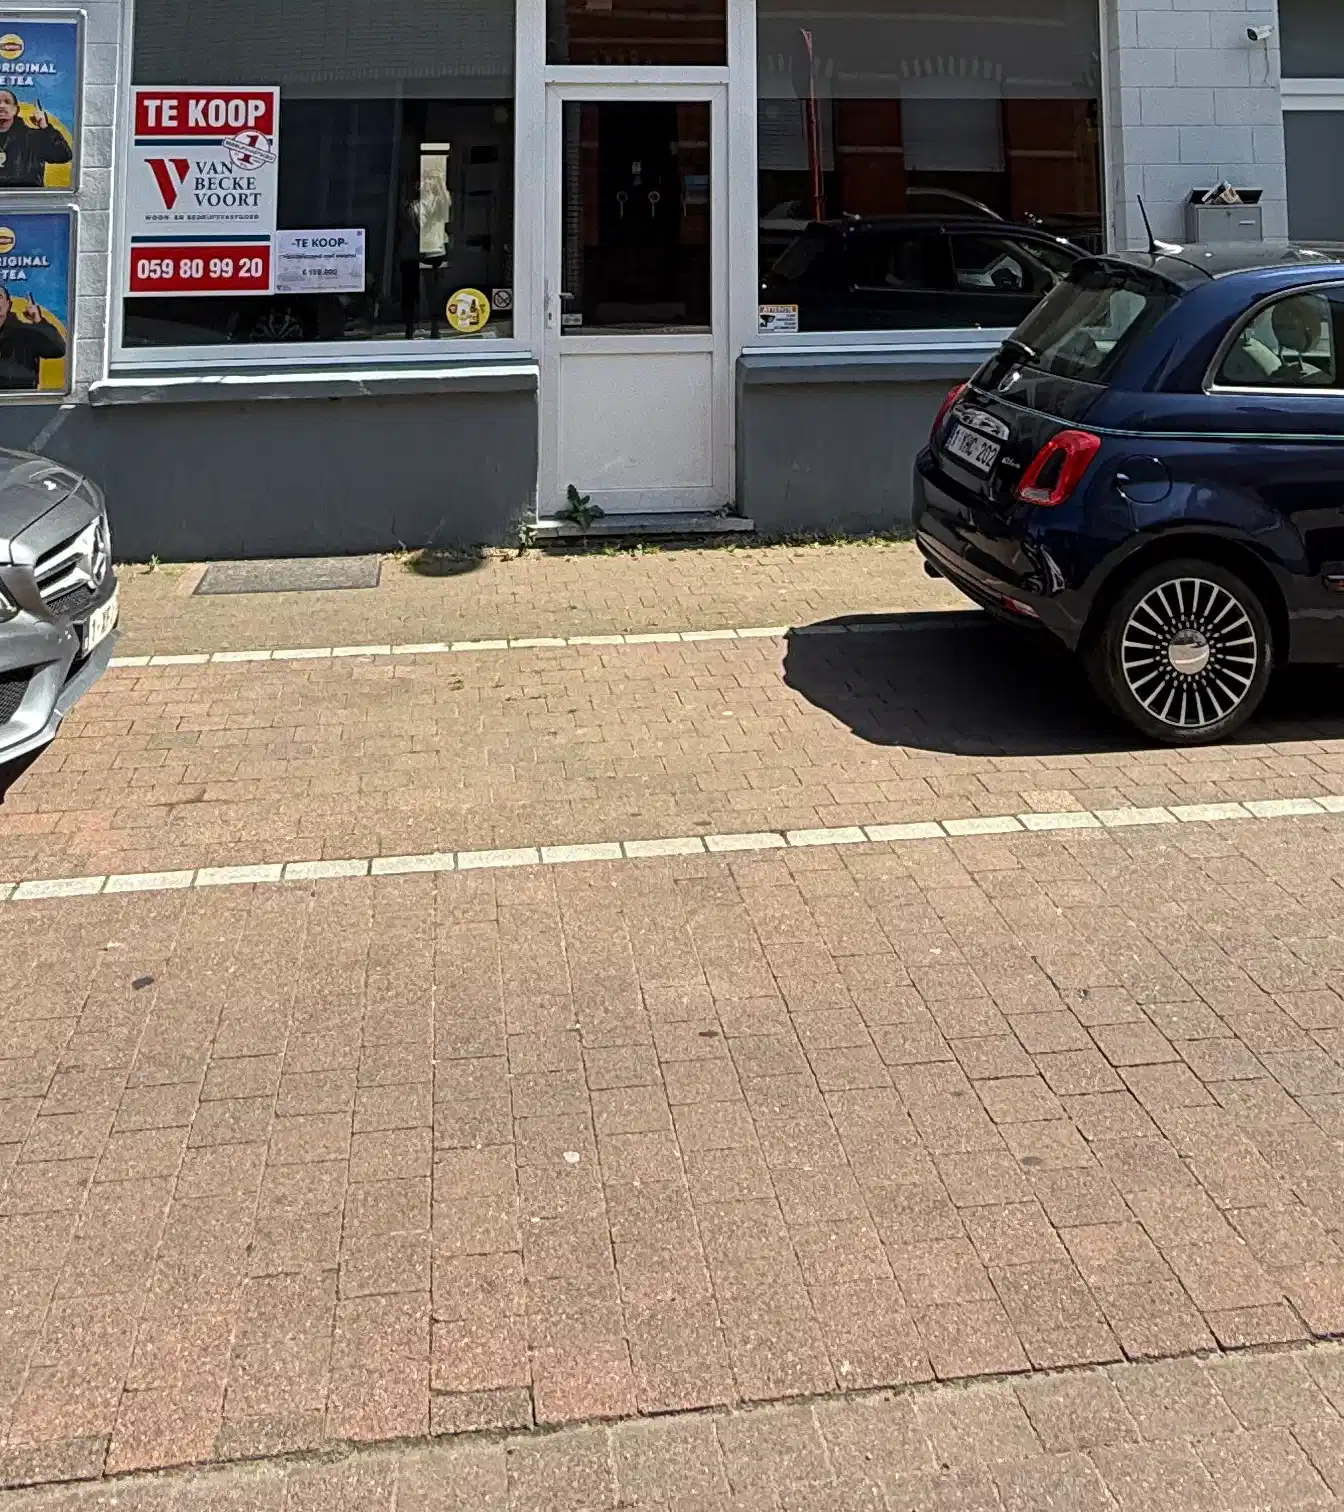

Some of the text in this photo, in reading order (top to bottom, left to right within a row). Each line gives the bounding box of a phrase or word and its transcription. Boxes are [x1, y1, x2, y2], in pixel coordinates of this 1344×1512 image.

[10, 75, 34, 86] TEA
[143, 99, 266, 128] TE KOOP
[195, 161, 234, 175] VAN
[194, 176, 257, 191] BECKE
[194, 192, 262, 207] VOORT
[1, 269, 28, 281] TEA
[137, 257, 263, 279] 059 80 99 20
